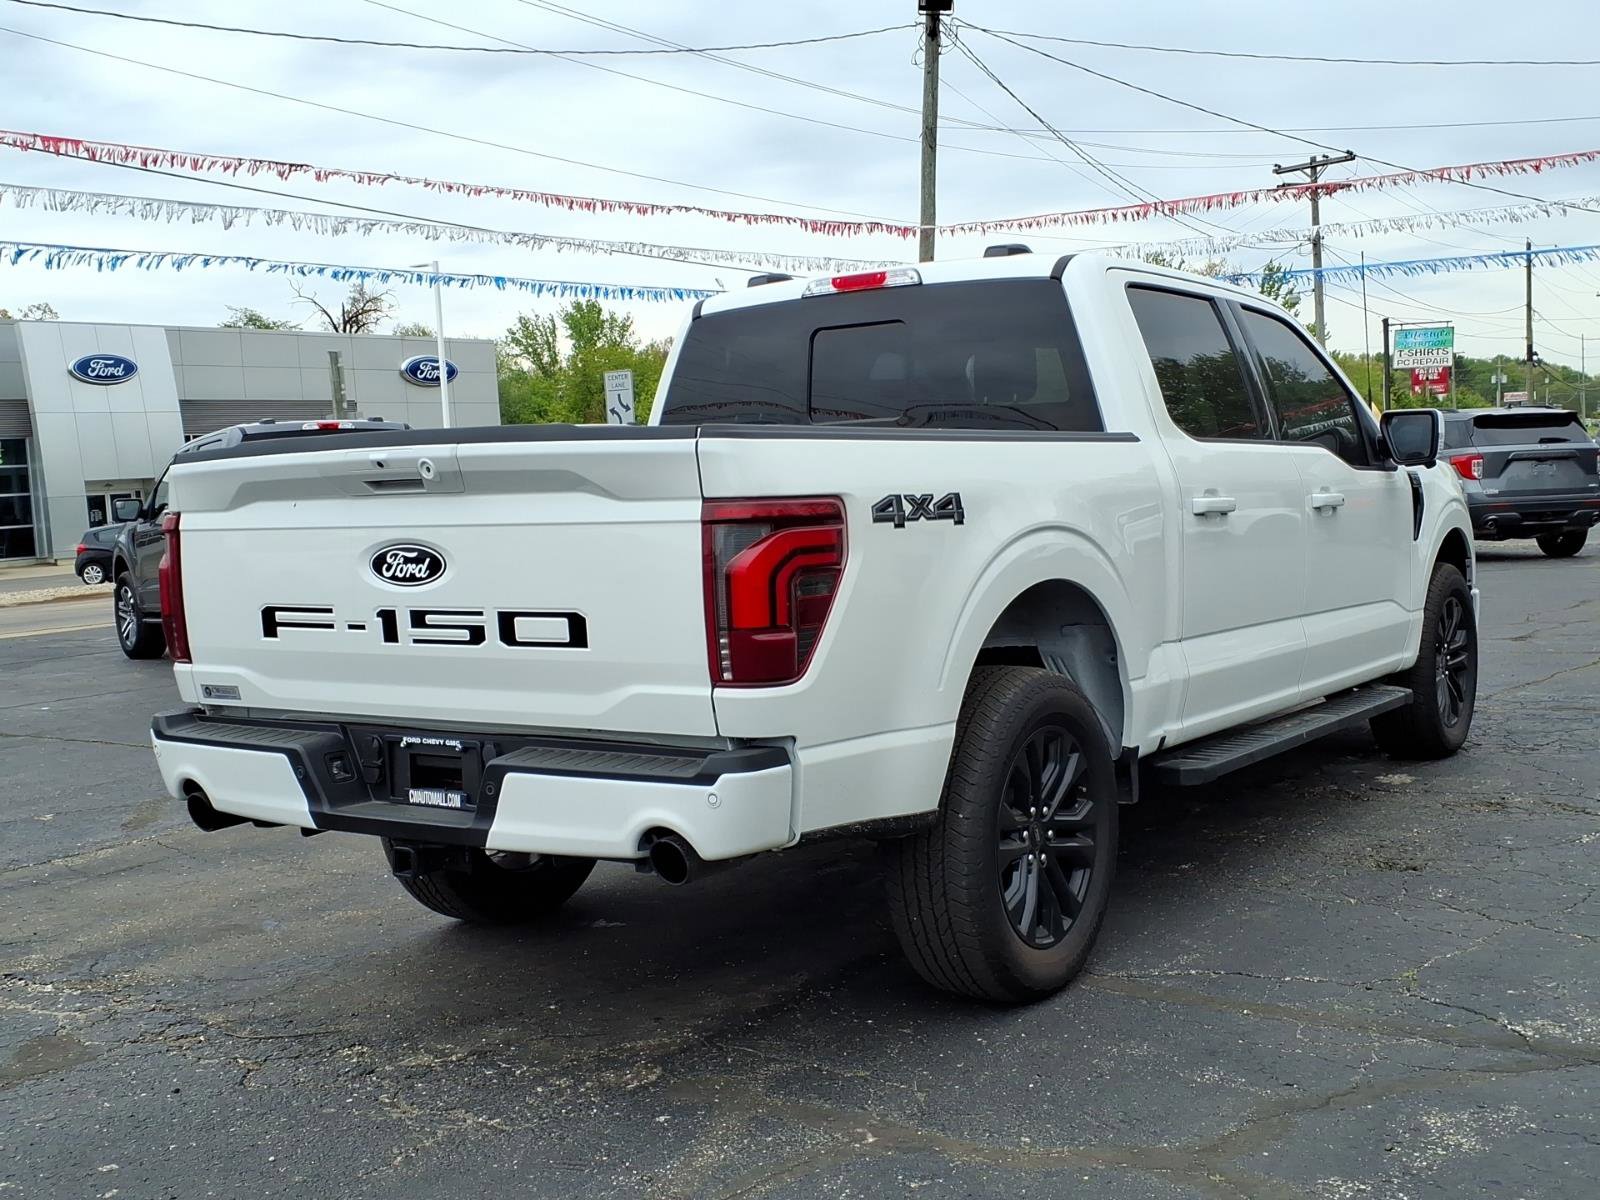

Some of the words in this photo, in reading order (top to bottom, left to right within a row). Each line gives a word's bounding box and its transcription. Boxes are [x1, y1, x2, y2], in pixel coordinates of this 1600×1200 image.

[1397, 347, 1449, 358] T-SHIRTS
[87, 359, 125, 377] Ford
[417, 361, 445, 379] For
[1397, 359, 1410, 367] PC
[1412, 358, 1449, 366] REPAIR
[381, 550, 430, 580] Ford
[260, 603, 591, 651] F-150
[408, 789, 461, 808] CWAUTOMALL.COM
